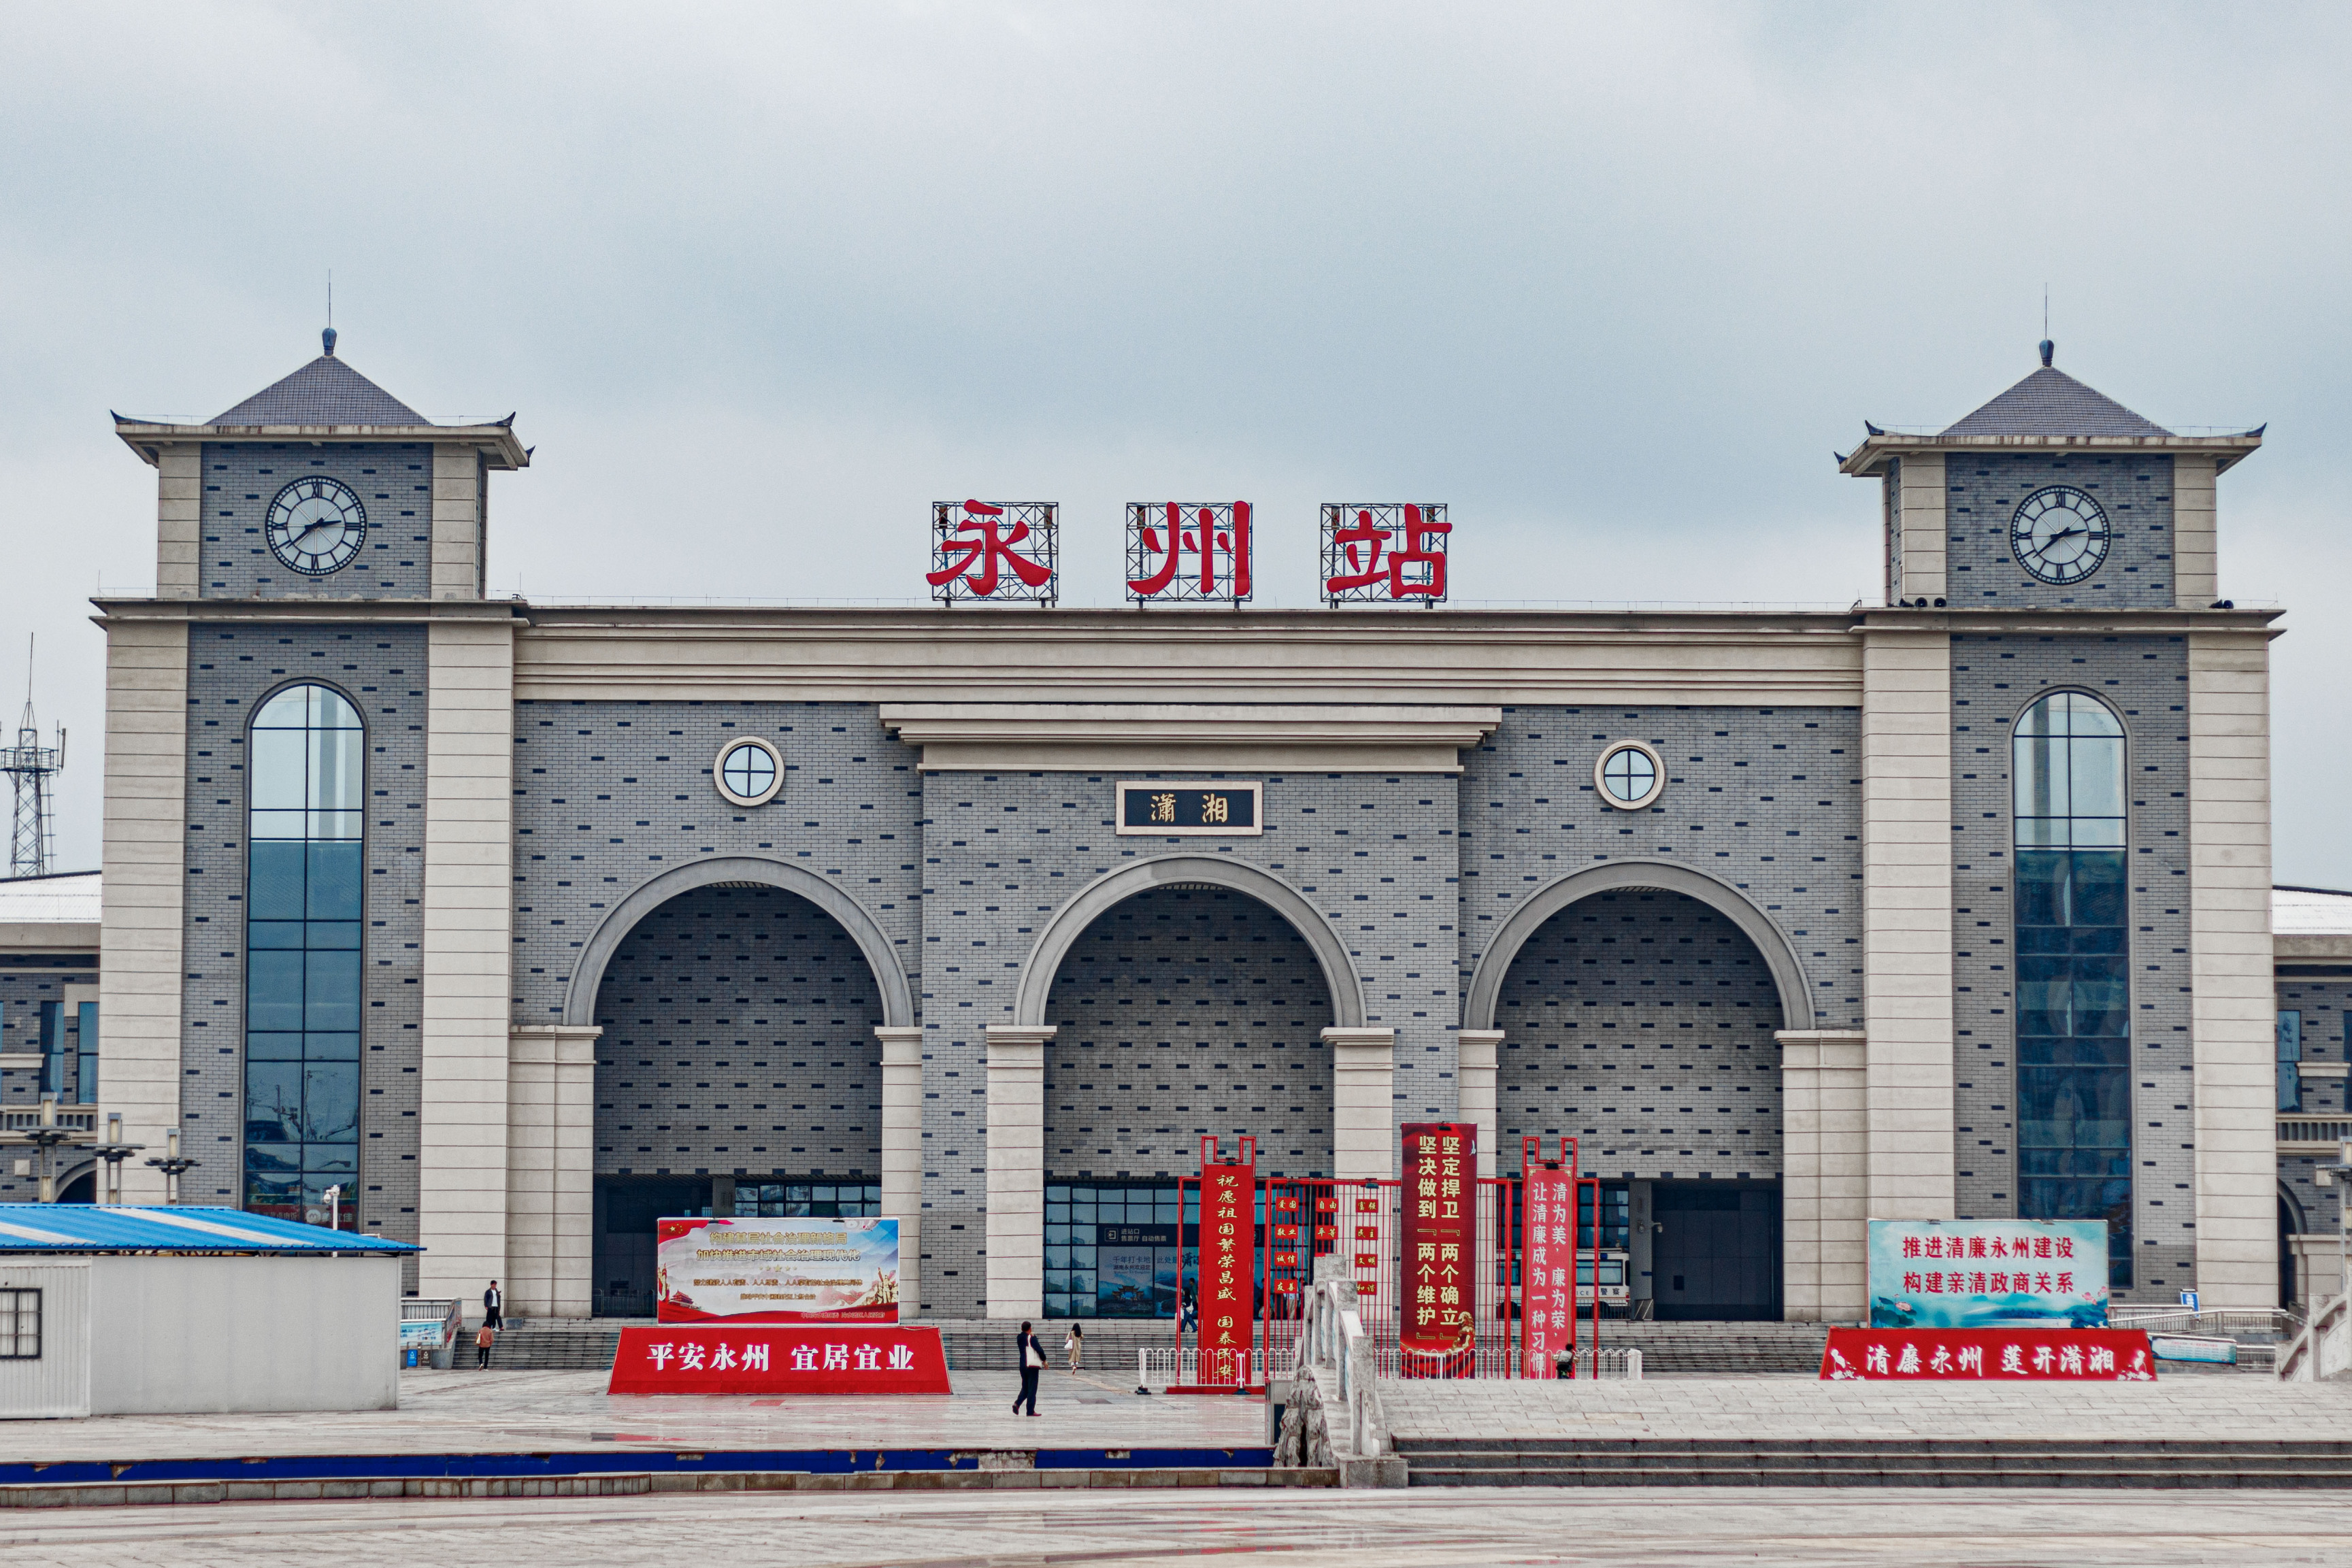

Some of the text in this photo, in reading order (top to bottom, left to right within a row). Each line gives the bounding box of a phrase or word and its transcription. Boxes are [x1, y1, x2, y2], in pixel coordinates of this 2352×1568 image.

[925, 499, 1453, 600] 永州站
[1278, 1199, 1297, 1210] 爱国
[1319, 1201, 1337, 1210] 自由
[1357, 1201, 1376, 1211] 富强
[1277, 1227, 1297, 1236] 敬业
[1317, 1227, 1336, 1237] 平等
[1357, 1229, 1374, 1238] 民主
[709, 1232, 848, 1245] 构建基层社会治理新格局
[1902, 1236, 2074, 1259] 推进清廉永州建设
[697, 1249, 861, 1261] 加快推进市域社会治理现代化
[1113, 1256, 1151, 1264] 千年打卡地
[1276, 1254, 1295, 1264] 诚信
[1357, 1256, 1376, 1265] 文明
[1214, 1173, 1239, 1377] 祝愿祖国繁荣昌盛 国泰民安
[1276, 1282, 1295, 1292] 友善
[1357, 1283, 1376, 1292] 和谐
[1902, 1271, 2074, 1295] 构建亲清政商关系
[1600, 1288, 1620, 1296] 警察
[646, 1342, 915, 1371] 平安永州 宜居宜业
[1866, 1345, 2115, 1378] 清廉永州 莲开潇湘
